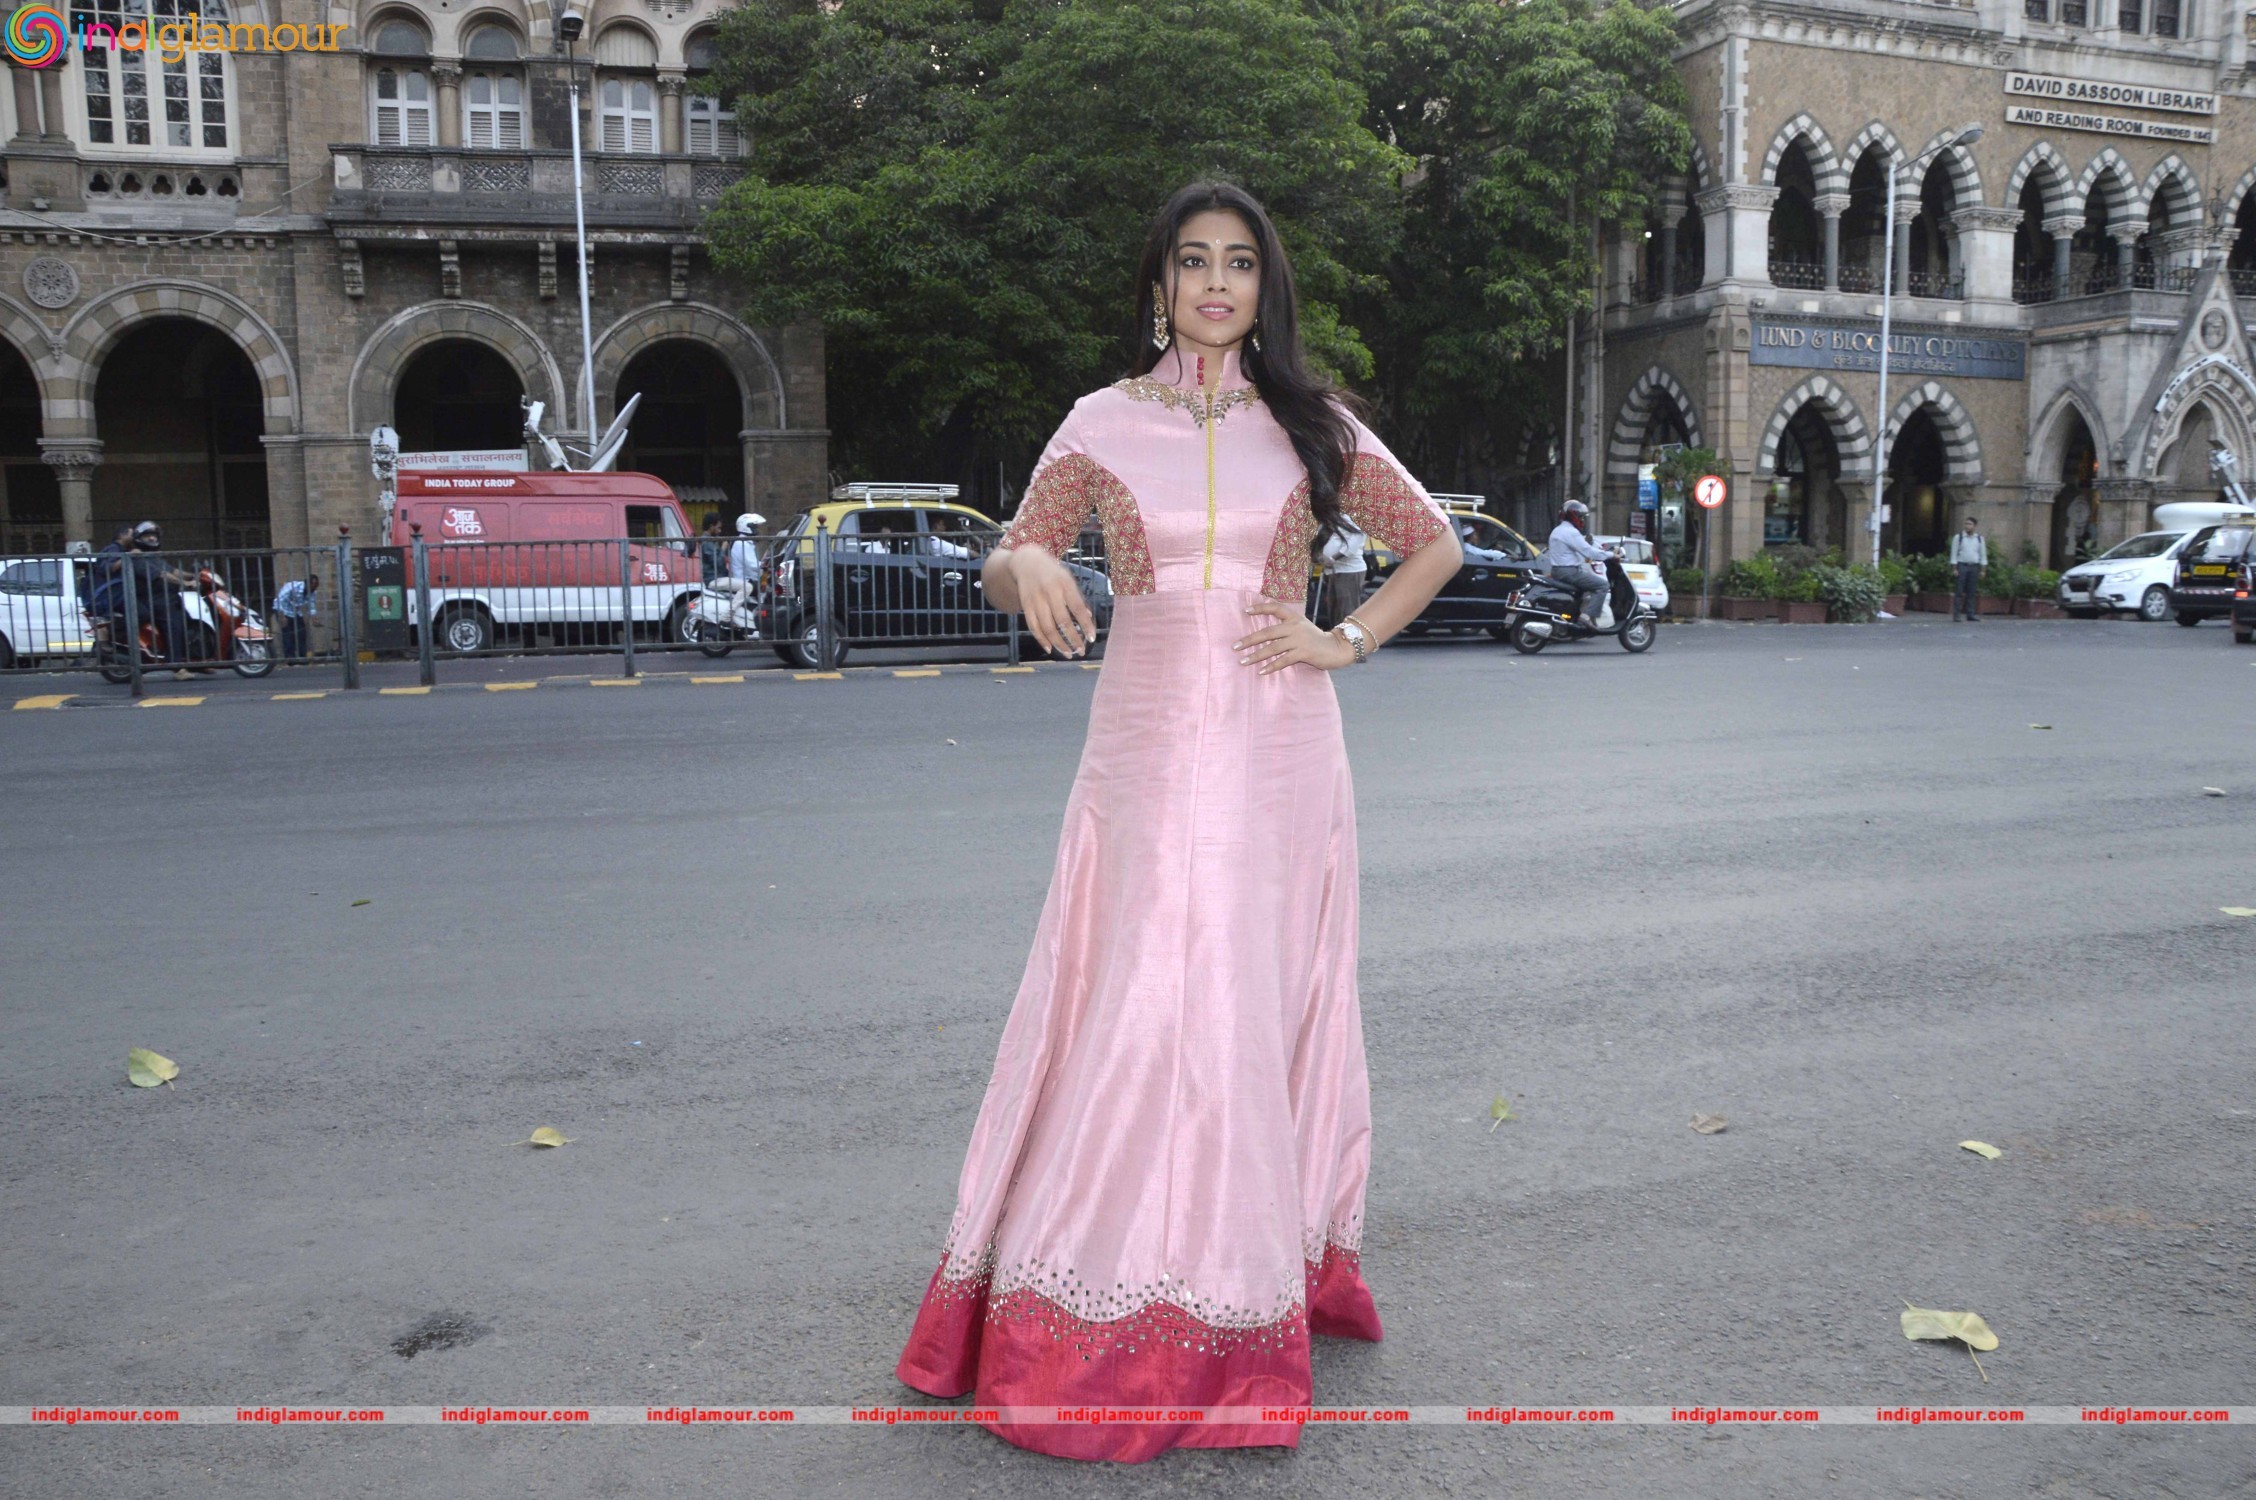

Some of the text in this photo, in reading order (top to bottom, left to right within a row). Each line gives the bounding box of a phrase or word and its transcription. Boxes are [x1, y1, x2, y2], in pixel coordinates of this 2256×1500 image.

[2013, 77, 2213, 110] DAVID SASSOON LIBRARY
[2016, 109, 2042, 122] AND
[2047, 112, 2103, 129] READING
[2106, 119, 2143, 133] ROOM
[2148, 126, 2191, 139] FOUNDED
[1760, 326, 1805, 347] LUND
[1811, 330, 1826, 348] &
[424, 479, 516, 487] INDIA TODAY GROUP
[444, 508, 475, 526] आज
[455, 521, 481, 534] तक
